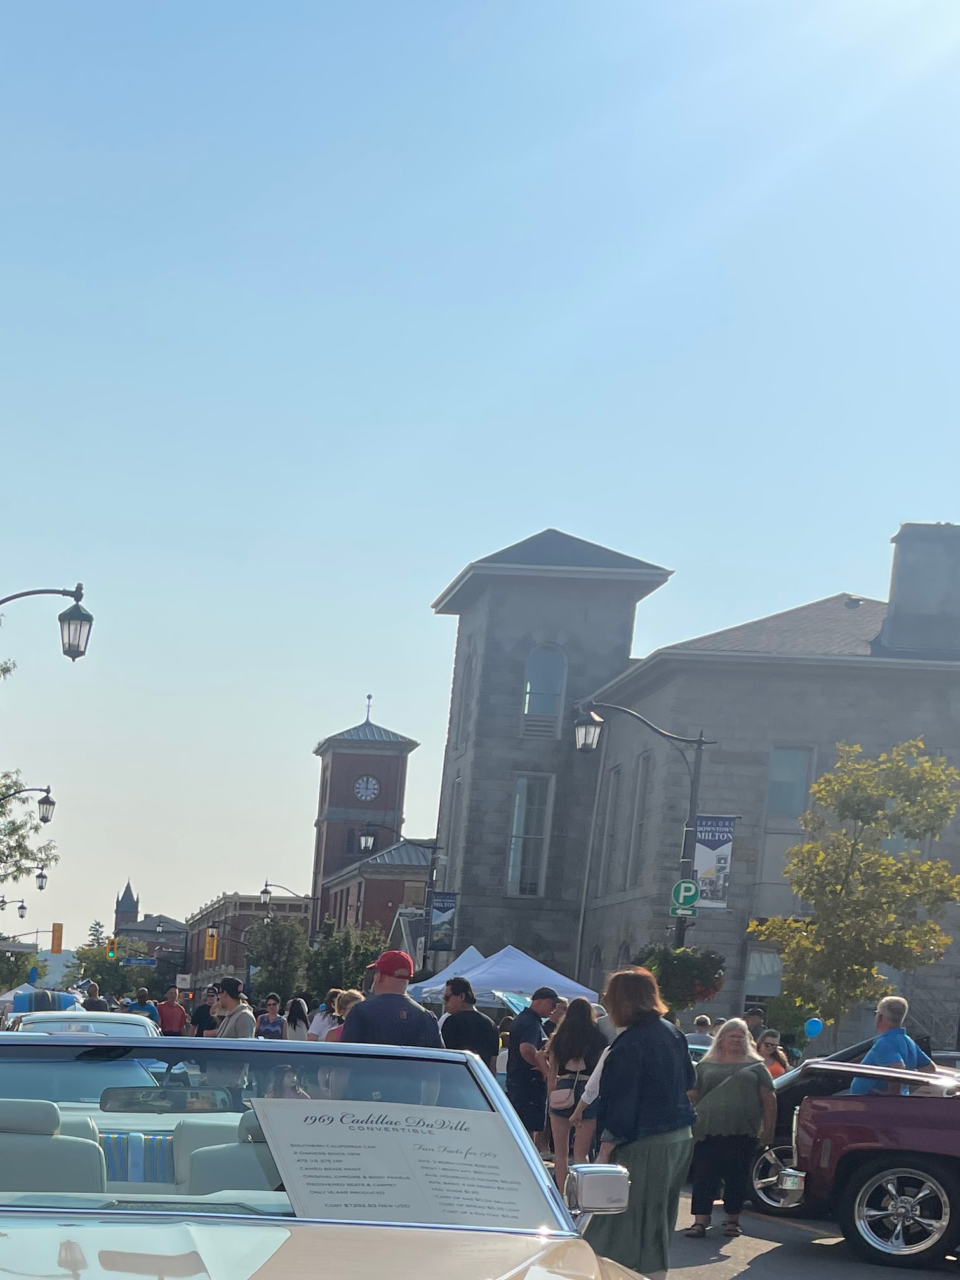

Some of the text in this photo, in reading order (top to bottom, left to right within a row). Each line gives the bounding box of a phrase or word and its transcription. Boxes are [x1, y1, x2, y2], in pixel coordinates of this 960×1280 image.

[696, 832, 733, 840] MILTON
[679, 883, 695, 904] P
[303, 1112, 471, 1132] 1969 Cadillac DaVille
[348, 1125, 435, 1135] CONVERTIBLE
[479, 1151, 498, 1159] 1969
